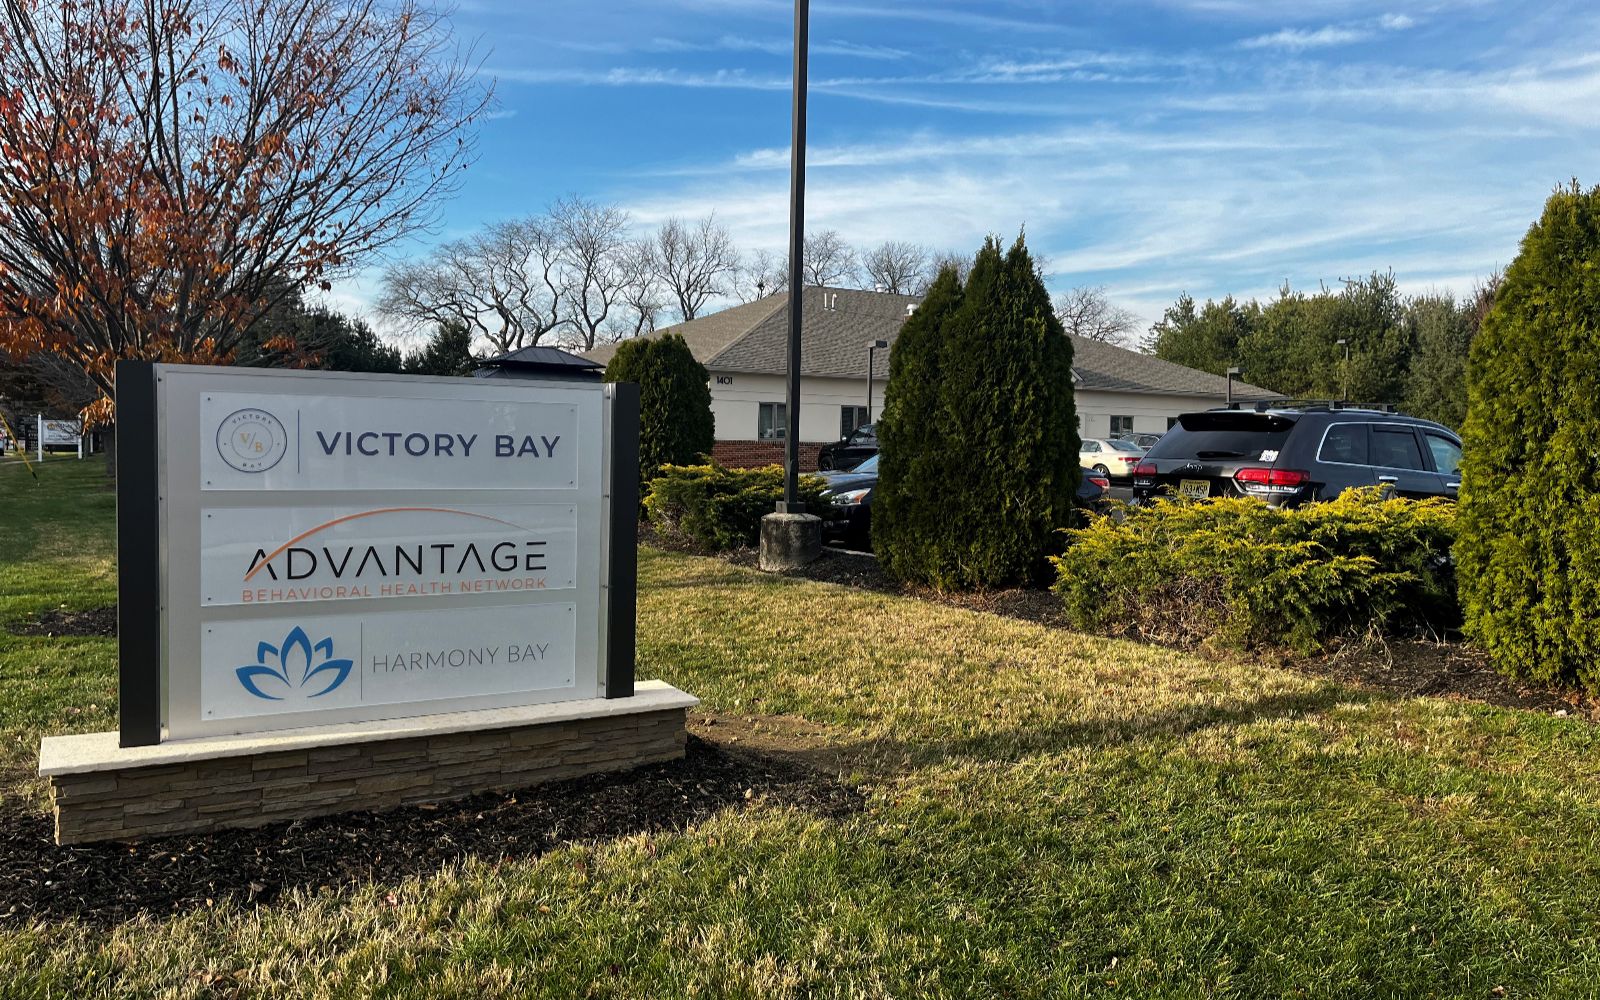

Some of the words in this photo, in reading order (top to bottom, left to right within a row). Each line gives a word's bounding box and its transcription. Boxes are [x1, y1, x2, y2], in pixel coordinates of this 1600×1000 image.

[716, 376, 733, 385] 1401
[232, 413, 272, 425] VICTORY
[316, 430, 478, 457] VICTORY
[495, 434, 561, 458] BAY
[244, 541, 547, 581] ADVANTAGE
[242, 585, 372, 602] BEHAVIORAL
[381, 581, 452, 597] HEALTH
[461, 577, 547, 592] NETWORK
[373, 646, 500, 673] HARMONY
[508, 642, 549, 664] BAY
